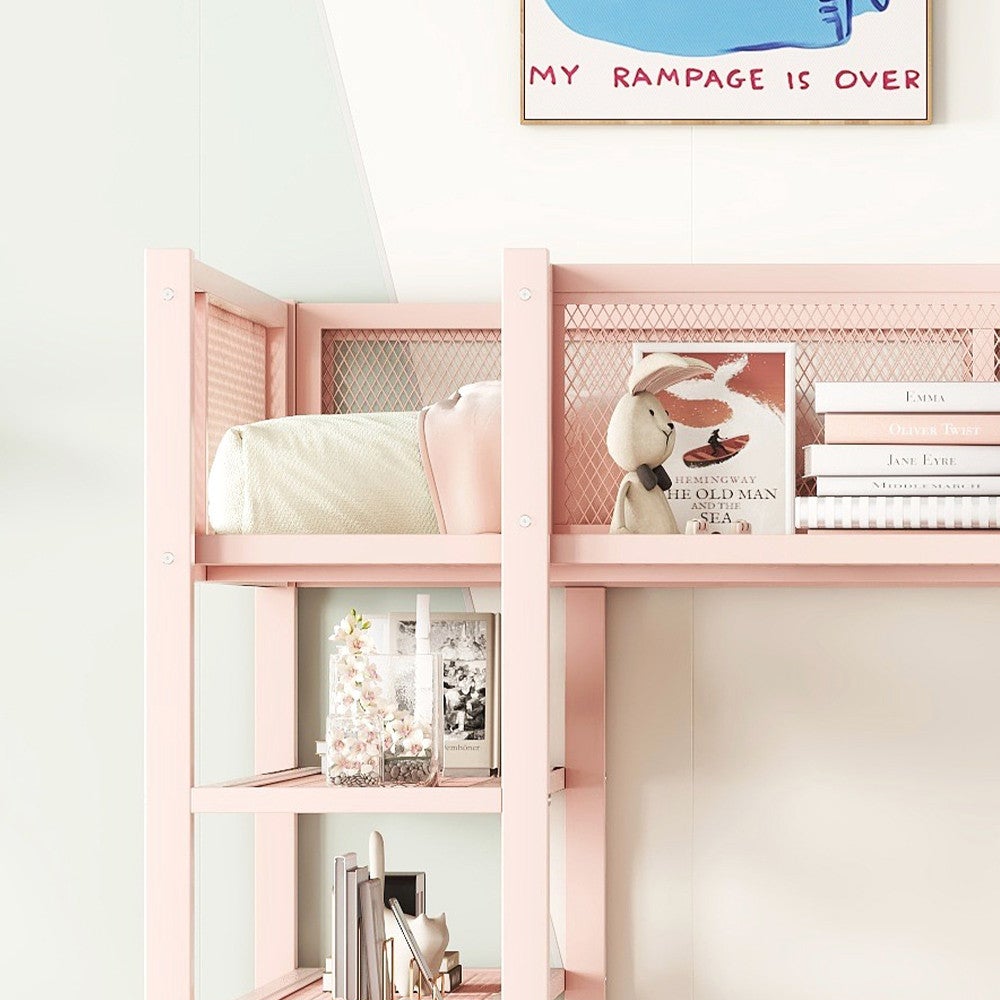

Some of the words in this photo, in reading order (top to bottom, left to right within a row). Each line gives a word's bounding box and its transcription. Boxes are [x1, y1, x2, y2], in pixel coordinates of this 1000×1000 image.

[529, 65, 579, 85] MY
[613, 67, 764, 90] RAMPAGE
[787, 71, 810, 90] IS
[835, 70, 920, 90] OVER
[675, 475, 757, 484] HEMINGWAY
[667, 489, 692, 500] HE
[696, 488, 734, 500] OLD
[739, 488, 778, 500] MAN
[700, 512, 732, 524] SEA
